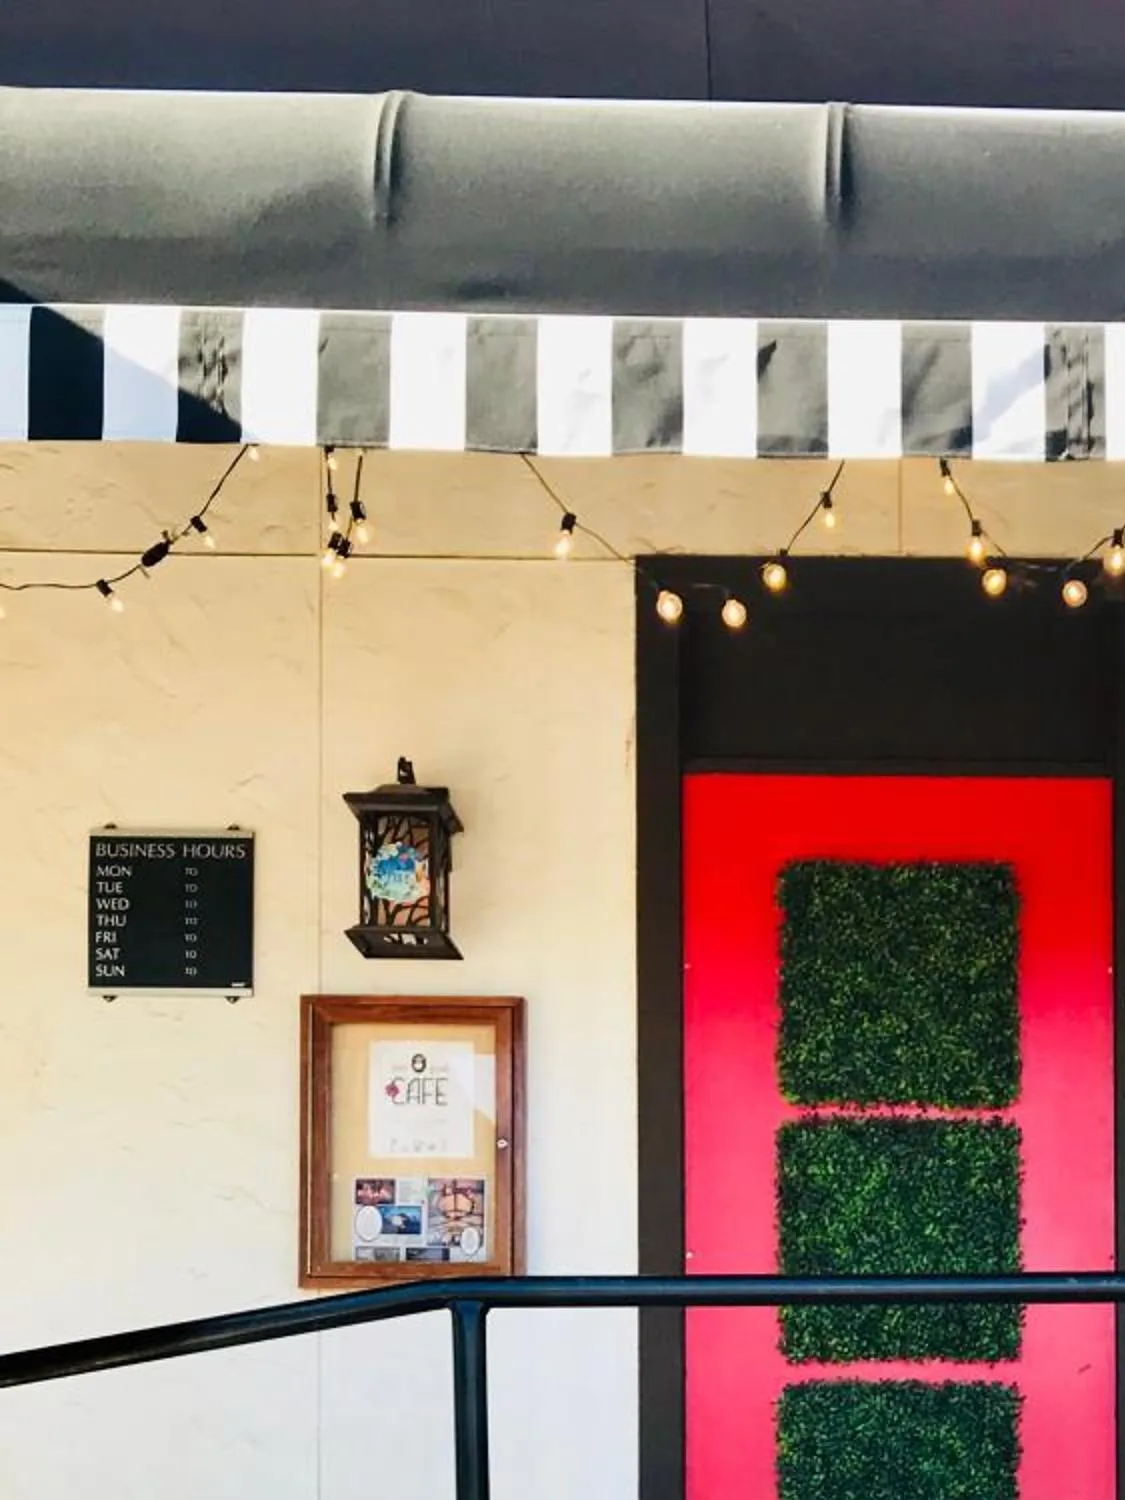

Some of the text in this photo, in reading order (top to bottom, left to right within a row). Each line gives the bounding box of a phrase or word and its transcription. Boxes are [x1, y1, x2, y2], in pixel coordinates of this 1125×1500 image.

[95, 843, 246, 858] BUSINESS HOURS
[96, 865, 132, 877] MON
[96, 881, 124, 893] TUE
[96, 898, 130, 910] WED
[96, 914, 127, 927] THU
[95, 931, 117, 944] FRI
[95, 948, 121, 960] SAT
[95, 964, 126, 977] SUN
